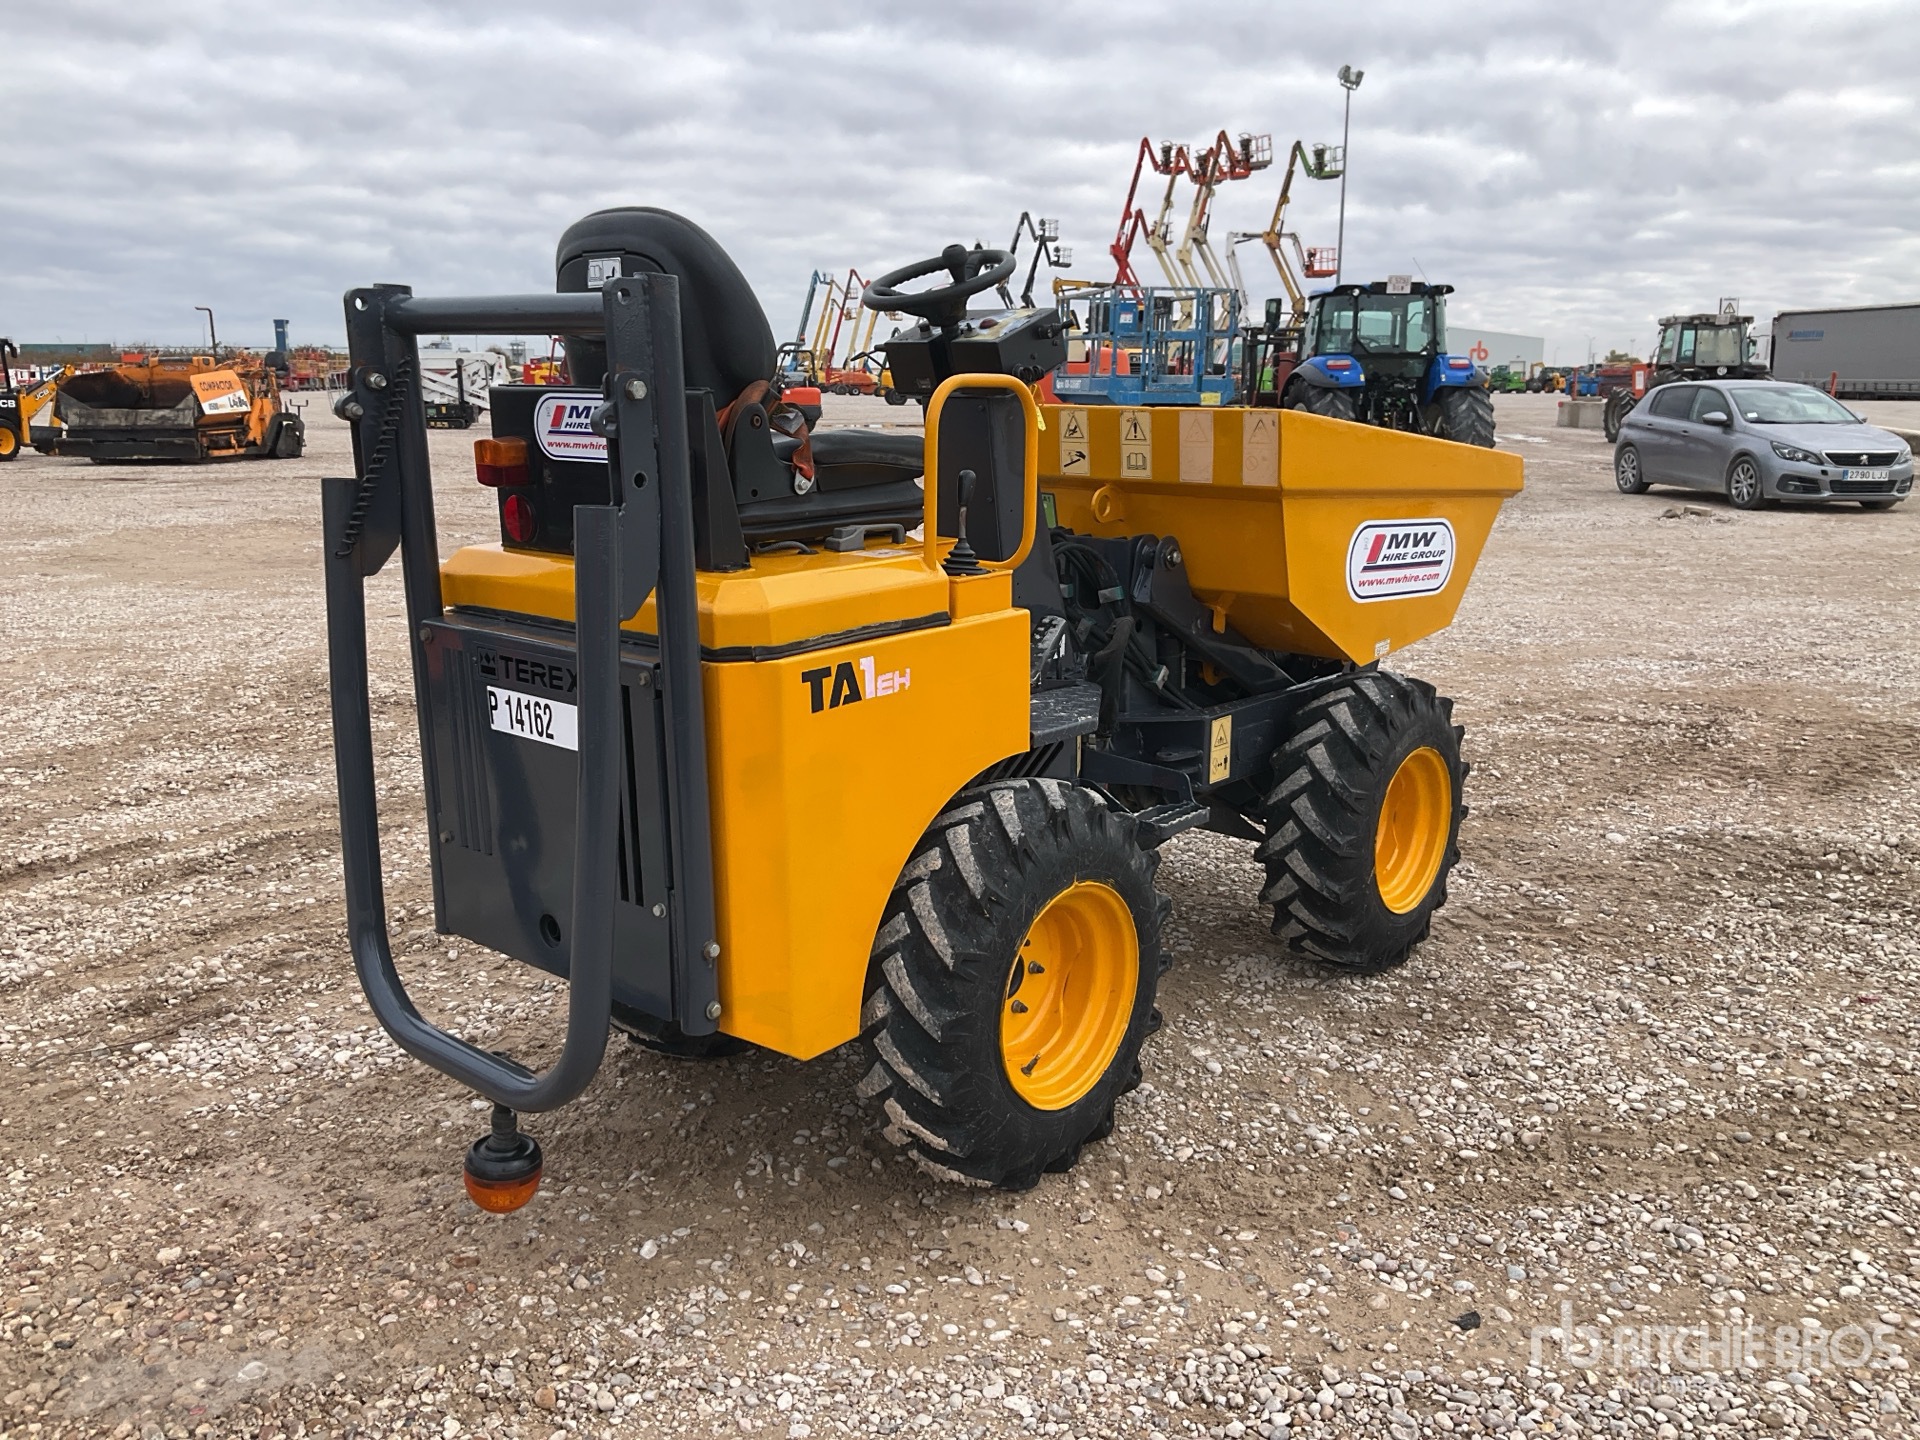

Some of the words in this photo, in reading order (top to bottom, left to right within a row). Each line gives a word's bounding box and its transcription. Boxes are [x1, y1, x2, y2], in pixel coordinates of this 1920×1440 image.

[1469, 340, 1489, 361] rb
[199, 380, 234, 392] COMPACTOR
[35, 388, 50, 401] JCB
[0, 400, 16, 408] CB
[567, 405, 600, 419] M
[547, 441, 608, 451] www.mwhire
[1849, 470, 1870, 479] 2790
[1871, 471, 1888, 480] LJJ
[1387, 531, 1437, 550] MW
[1381, 552, 1409, 562] HIRE
[1410, 550, 1446, 560] GROUP
[1358, 572, 1440, 587] www.mwhire.com
[499, 654, 578, 693] TEREX
[488, 690, 498, 725] P
[504, 694, 555, 740] 14162
